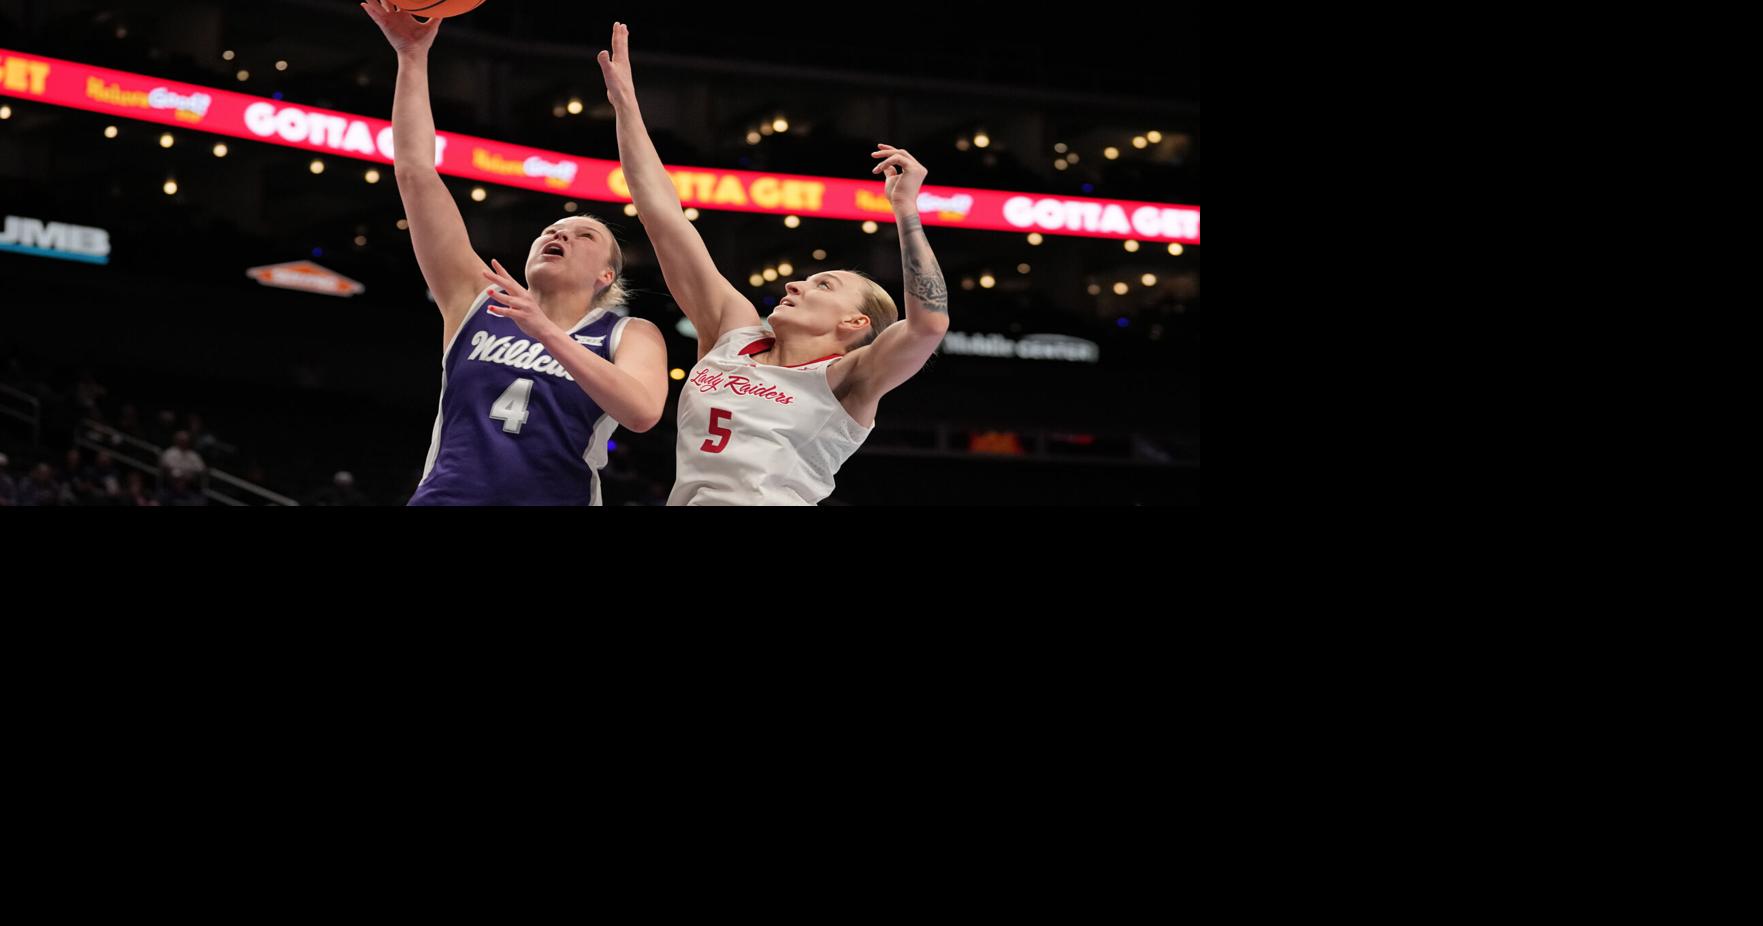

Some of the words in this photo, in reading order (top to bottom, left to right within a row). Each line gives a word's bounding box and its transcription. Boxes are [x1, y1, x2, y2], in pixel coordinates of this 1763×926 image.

[0, 56, 50, 95] ET
[244, 102, 375, 155] GOTTA
[376, 125, 447, 168] GT
[608, 165, 747, 205] GTTA
[752, 176, 825, 211] GET
[1003, 196, 1130, 235] GOTTA
[1132, 206, 1200, 239] GET
[489, 378, 534, 435] 4
[690, 368, 724, 393] Lady
[724, 375, 794, 405] Raiders
[700, 407, 733, 454] 5
